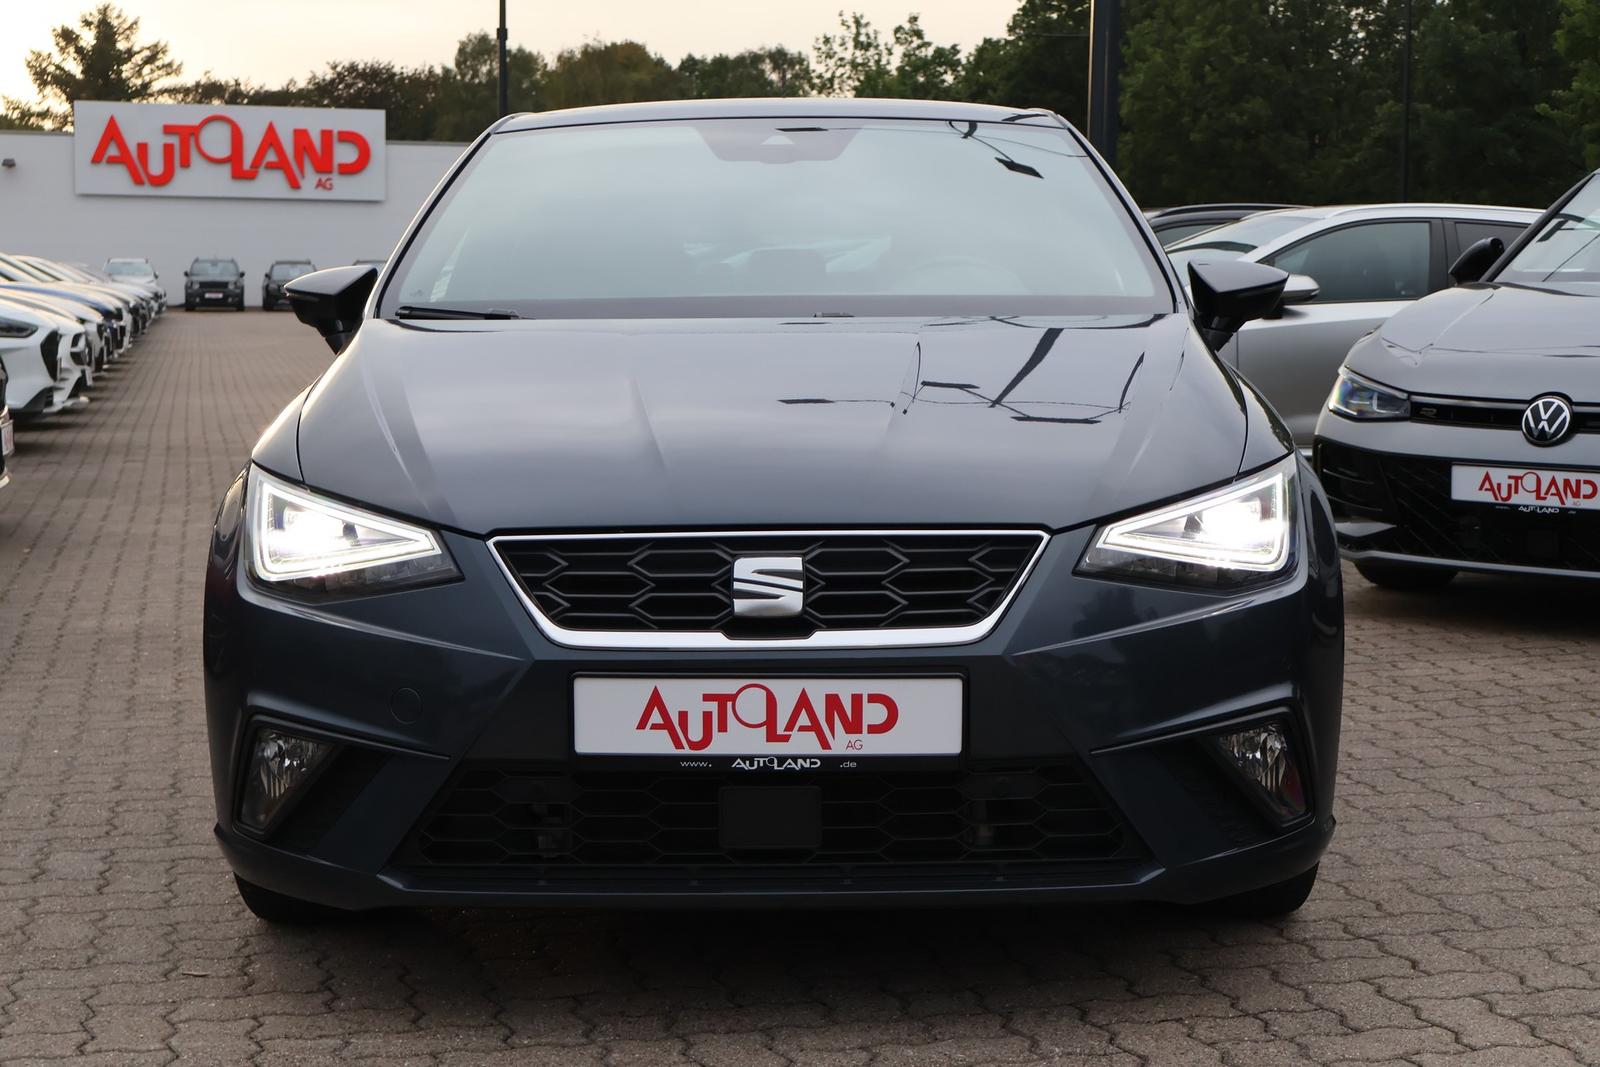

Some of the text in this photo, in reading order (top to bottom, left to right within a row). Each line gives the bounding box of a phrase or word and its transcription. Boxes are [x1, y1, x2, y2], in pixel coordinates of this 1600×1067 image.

[91, 114, 371, 189] AUTOLAND
[315, 178, 333, 190] AG
[1478, 470, 1598, 505] AUTOLAND
[635, 683, 899, 751] AUTOLAND
[845, 739, 864, 751] AG
[731, 756, 821, 770] AUTOLAND
